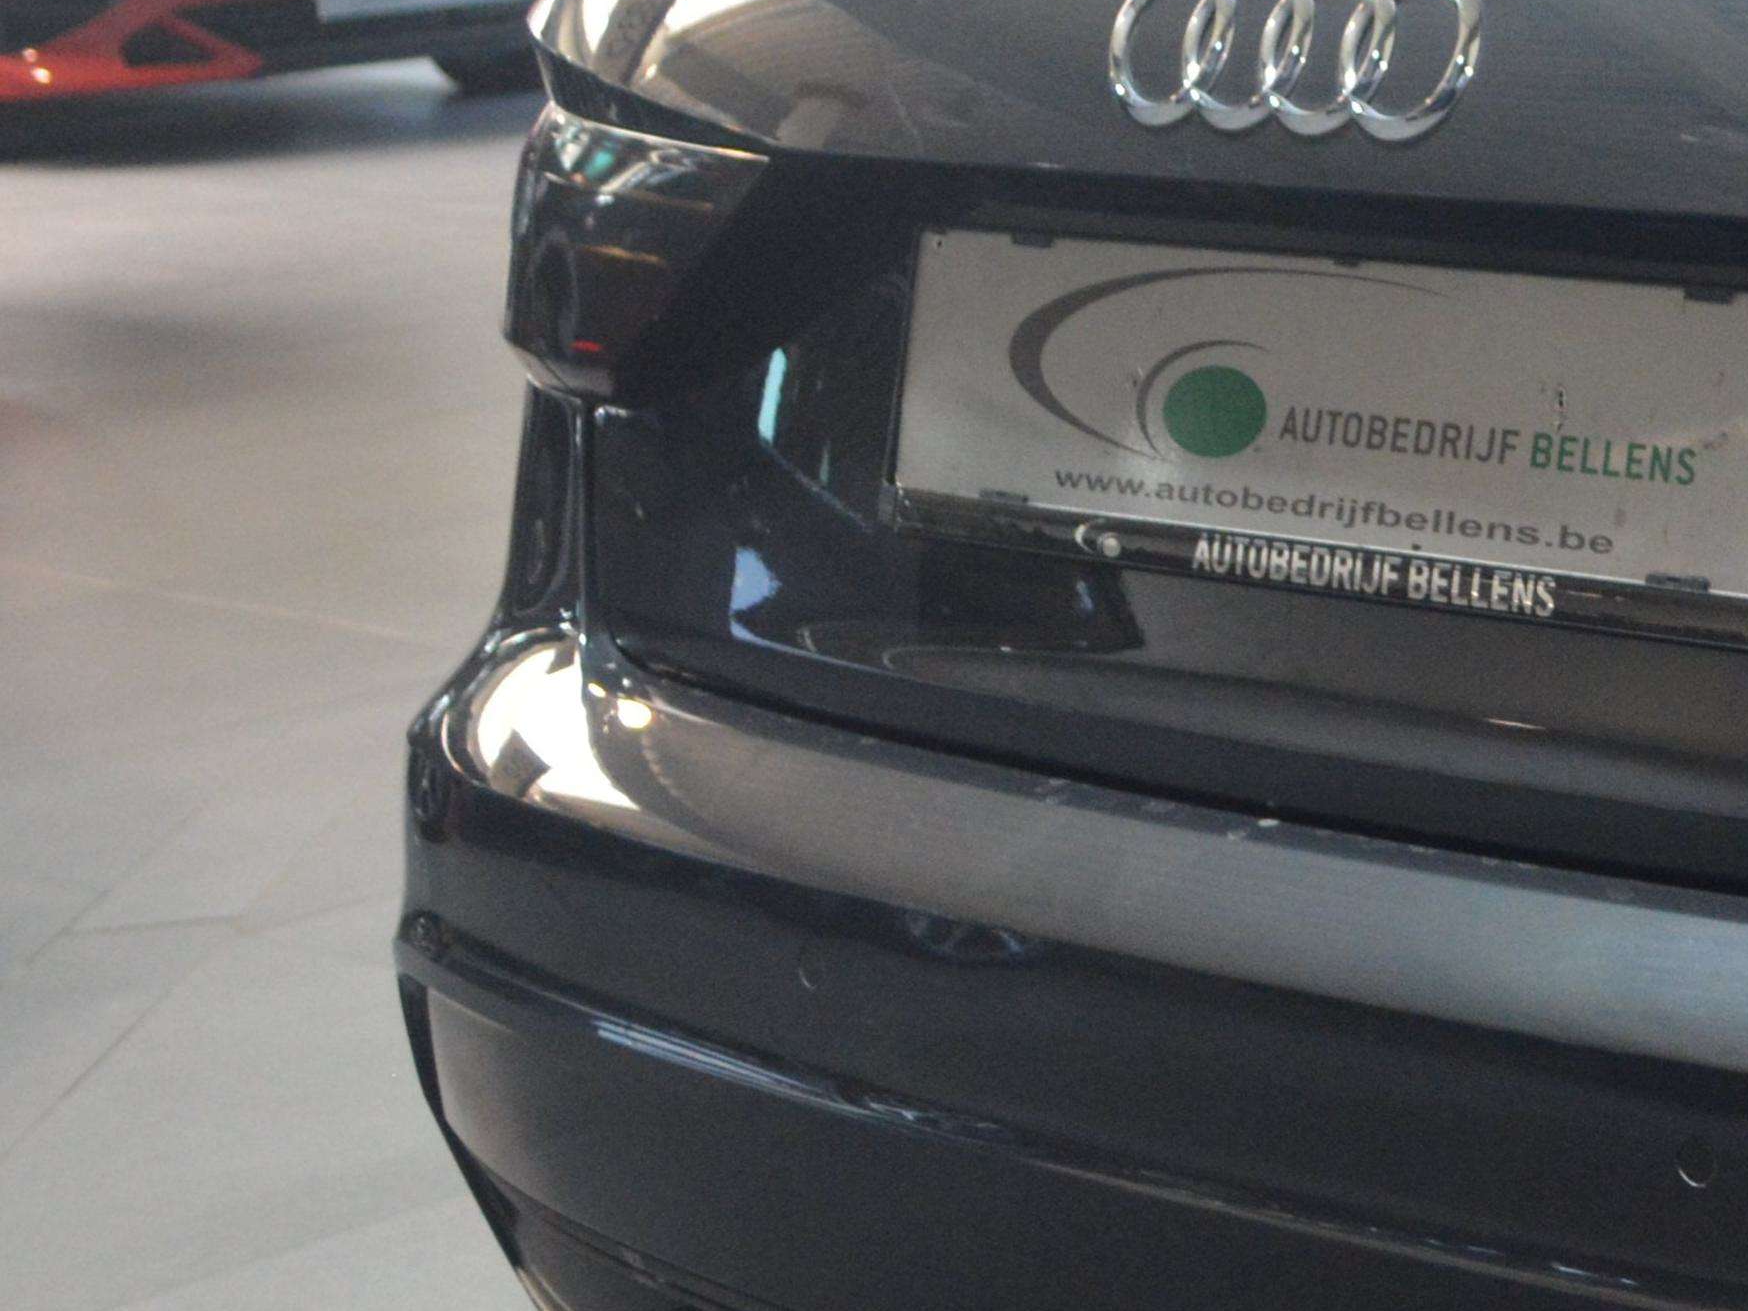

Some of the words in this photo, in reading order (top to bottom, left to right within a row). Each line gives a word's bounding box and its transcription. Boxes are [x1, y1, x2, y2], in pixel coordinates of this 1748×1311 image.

[1279, 405, 1522, 466] AUTOBEDRIJF
[1529, 431, 1698, 486] BELLENS
[1053, 467, 1615, 556] www.autobedrijfbellens.be
[1191, 532, 1401, 598] AUTOBEDRIJF
[1406, 560, 1557, 618] BELLENS
